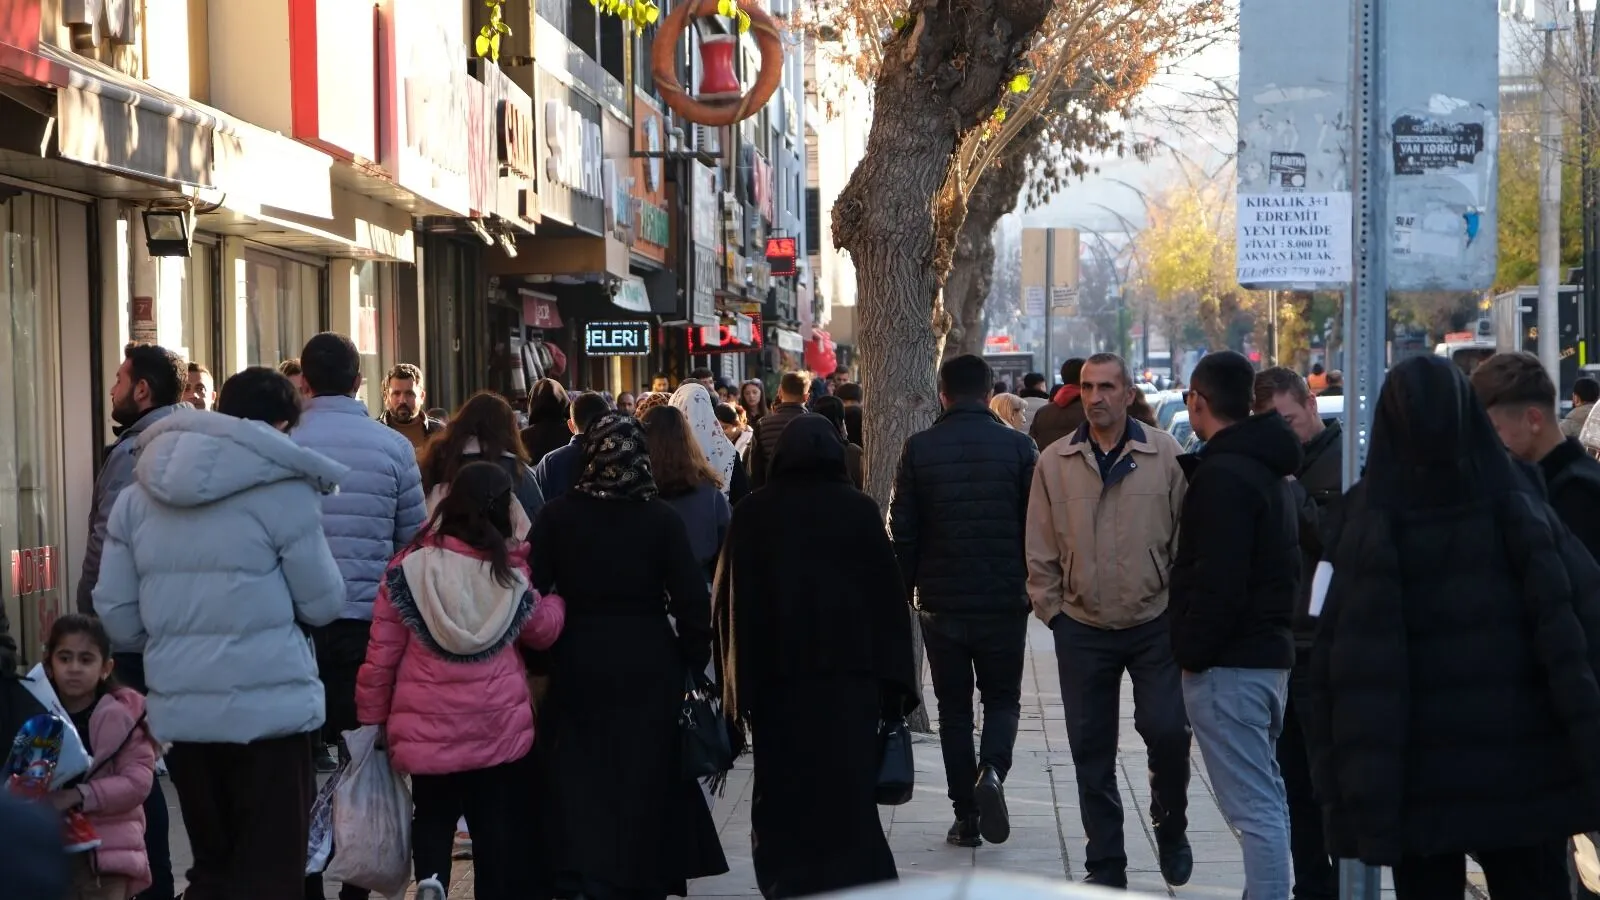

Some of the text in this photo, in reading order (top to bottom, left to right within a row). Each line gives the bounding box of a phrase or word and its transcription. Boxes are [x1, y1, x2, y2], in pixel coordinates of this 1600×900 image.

[1400, 143, 1420, 154] VAN
[1246, 196, 1328, 207] KIRALIK 3+1
[1256, 209, 1320, 221] EDREMİT
[1243, 223, 1332, 236] YENİ TOKİDE
[1245, 239, 1278, 248] FİYAT
[1287, 240, 1313, 248] 8.000
[1242, 251, 1286, 260] AKMAN
